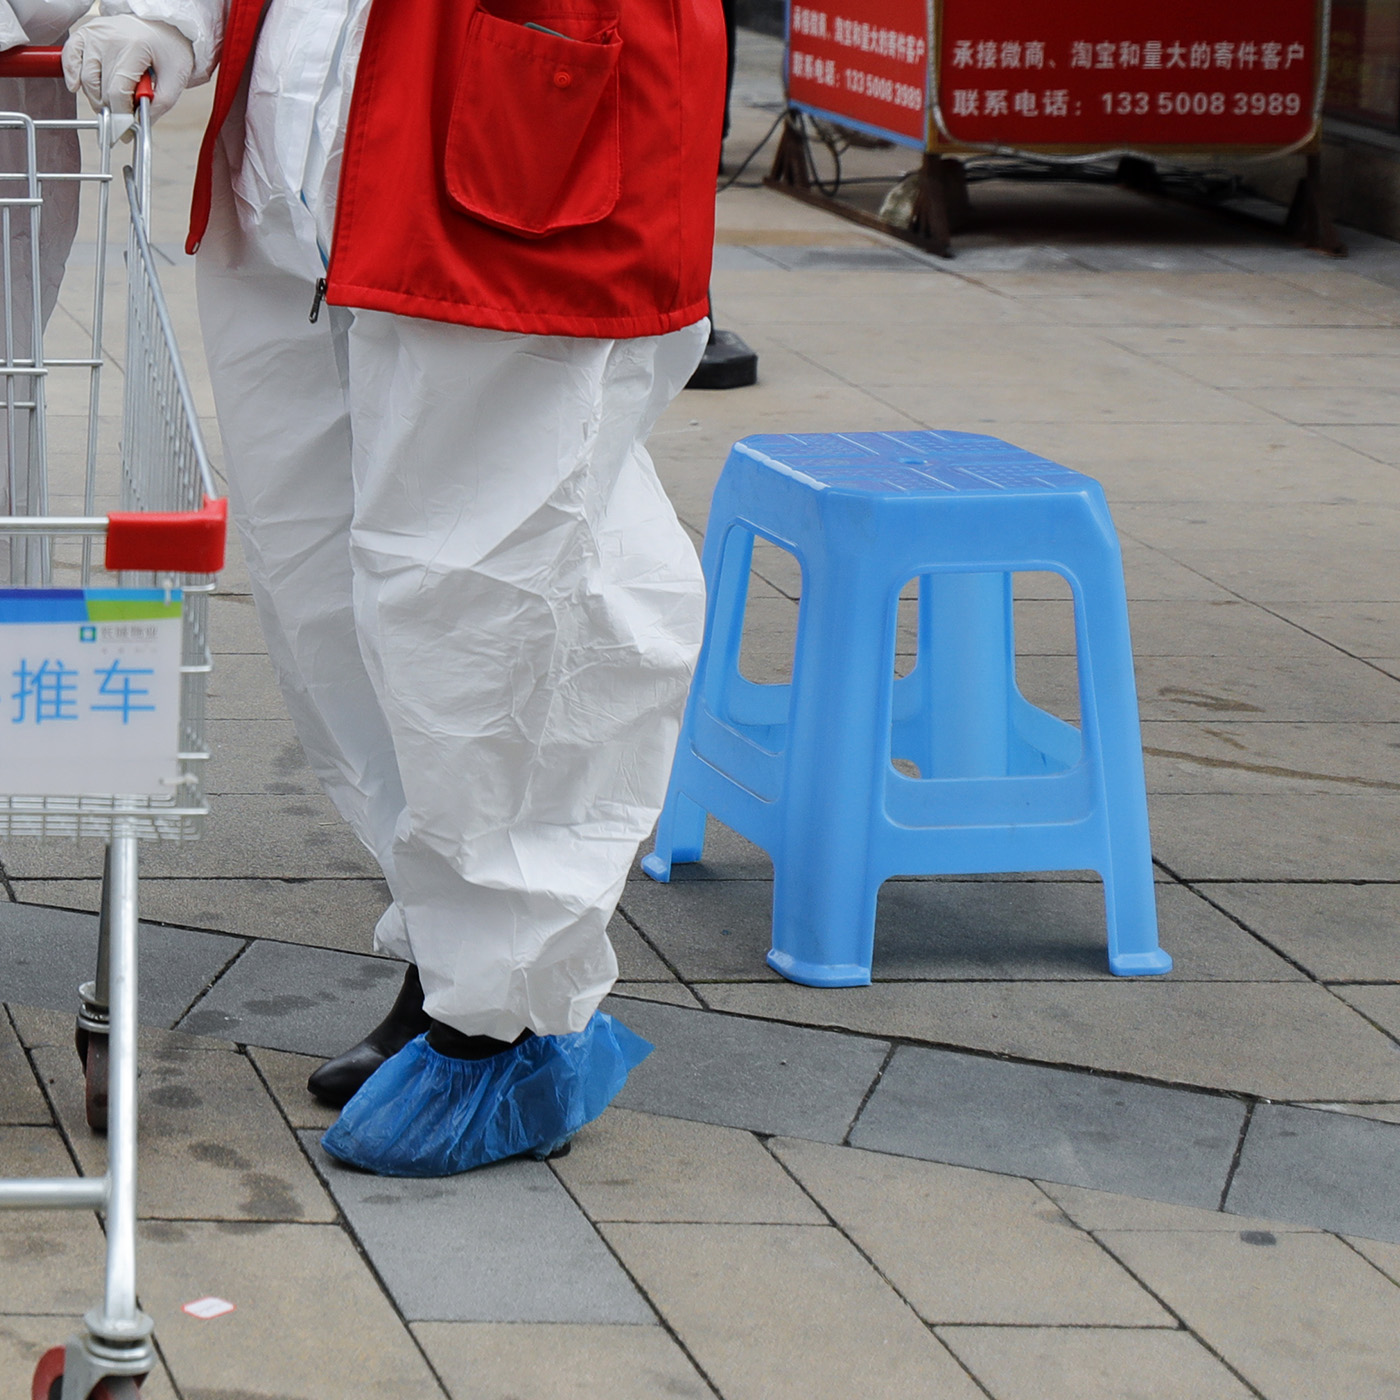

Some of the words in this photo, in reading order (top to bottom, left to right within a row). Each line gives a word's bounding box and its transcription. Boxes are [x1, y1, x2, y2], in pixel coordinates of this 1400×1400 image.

[1102, 92, 1150, 116] 133
[1158, 92, 1226, 116] 5008
[1233, 92, 1301, 116] 3989
